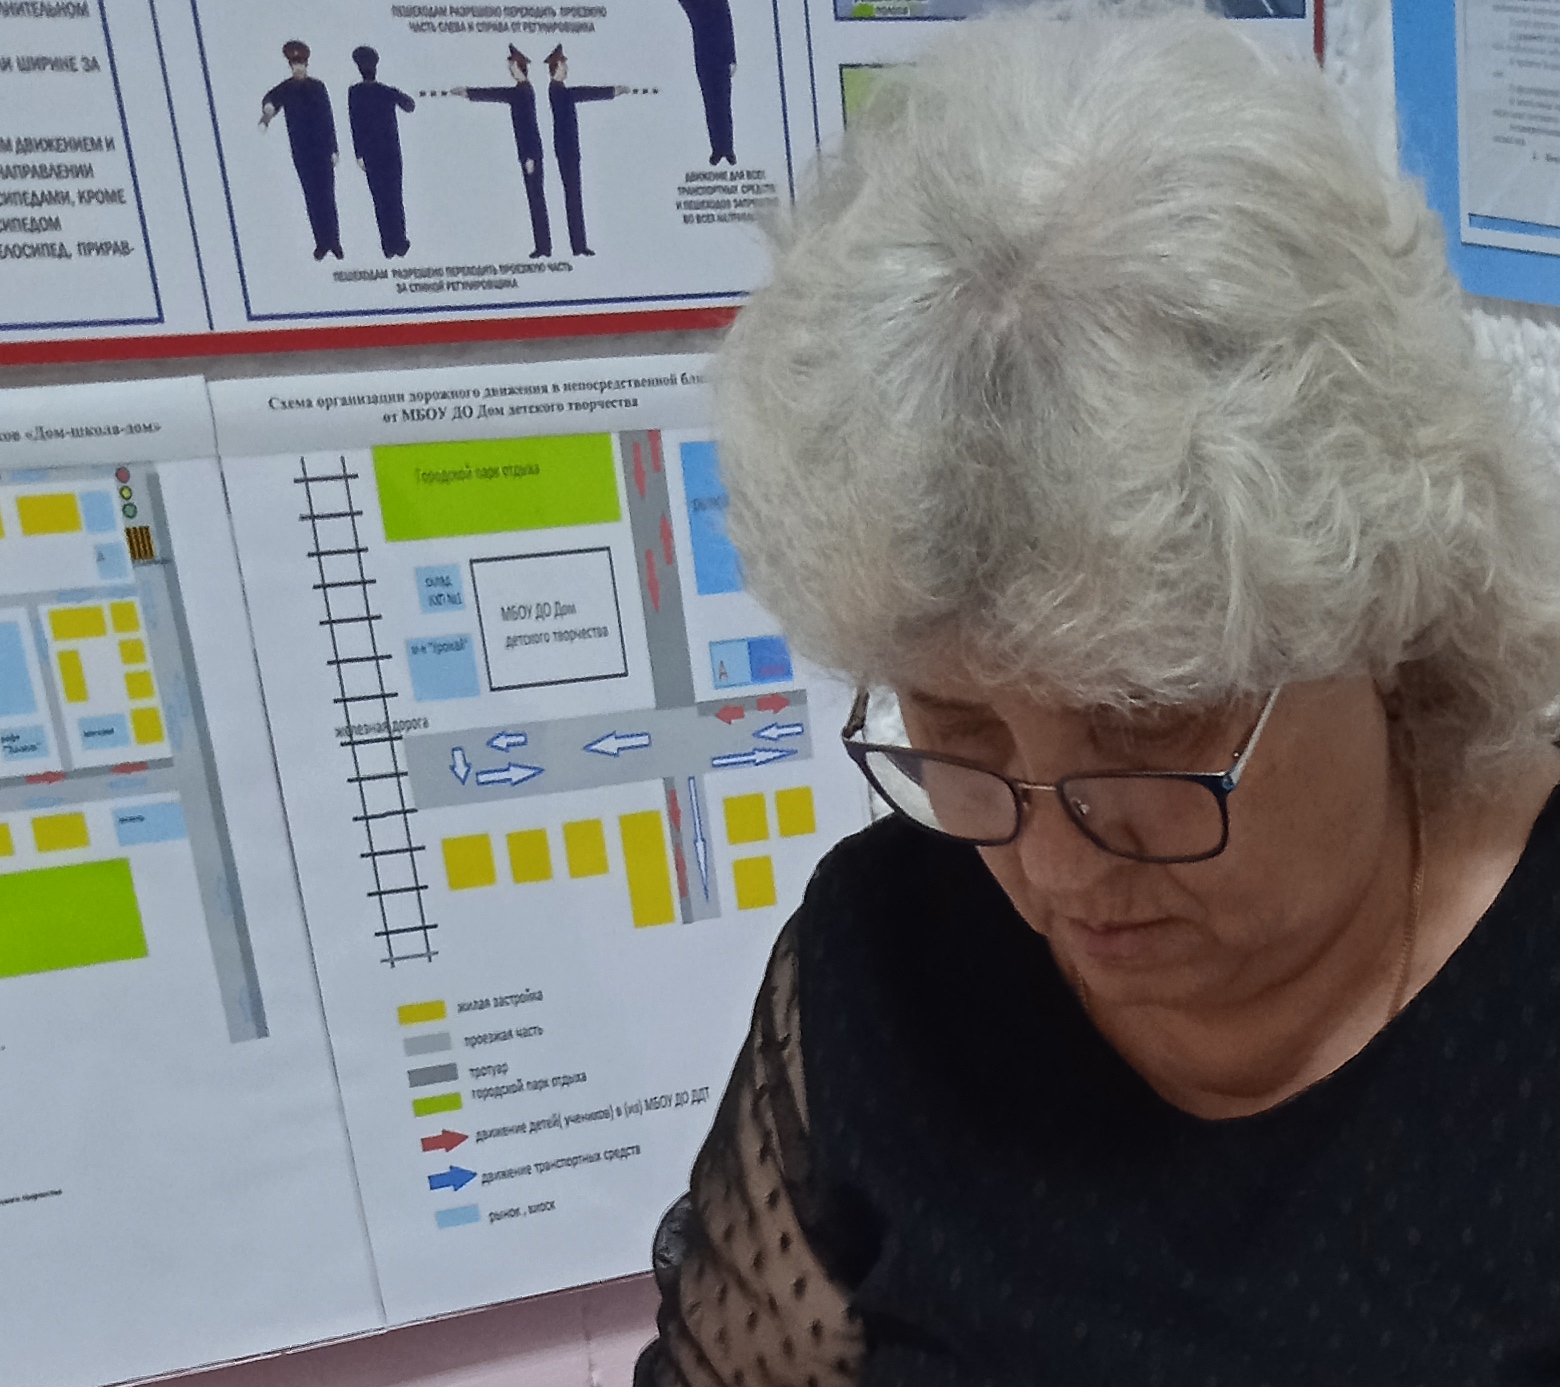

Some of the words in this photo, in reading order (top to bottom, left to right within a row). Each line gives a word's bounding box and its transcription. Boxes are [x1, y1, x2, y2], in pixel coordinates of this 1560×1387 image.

[16, 55, 79, 72] ШИРИНЕ
[81, 55, 100, 72] ЗА
[15, 136, 103, 154] ДВИЖЕНИЕМ
[105, 136, 115, 150] И
[77, 188, 127, 205] КРОМЕ
[77, 240, 135, 256] ПРИРАВ-
[268, 397, 314, 411] Схема
[316, 393, 405, 411] организации
[408, 386, 480, 404] дорожного
[483, 383, 549, 399] движения
[552, 381, 560, 393] в
[563, 373, 678, 393] непосредственной
[383, 413, 398, 424] от
[401, 406, 447, 422] МБОУ
[452, 406, 473, 421] ДО
[477, 402, 505, 419] Дом
[508, 402, 565, 416] детского
[568, 397, 639, 413] творчества
[501, 604, 532, 622] МБОУ
[535, 602, 552, 621] ДО
[554, 600, 577, 619] Дом
[505, 632, 550, 649] детского
[553, 626, 609, 643] творчества
[392, 717, 430, 733] дорога
[457, 997, 491, 1013] жилая
[493, 988, 543, 1008] застройка
[464, 1030, 512, 1048] проезжая
[516, 1025, 544, 1038] часть
[469, 1062, 509, 1079] тротуар
[471, 1078, 524, 1100] городской
[526, 1079, 550, 1094] парк
[552, 1071, 587, 1088] отдыха
[475, 1123, 527, 1143] движение
[644, 1095, 673, 1113] МБОУ
[675, 1091, 690, 1108] ДО
[691, 1086, 710, 1105] ДДТ
[481, 1164, 532, 1185] движение
[534, 1153, 601, 1174] транспортных
[604, 1144, 641, 1163] средств
[488, 1207, 521, 1223] рынок
